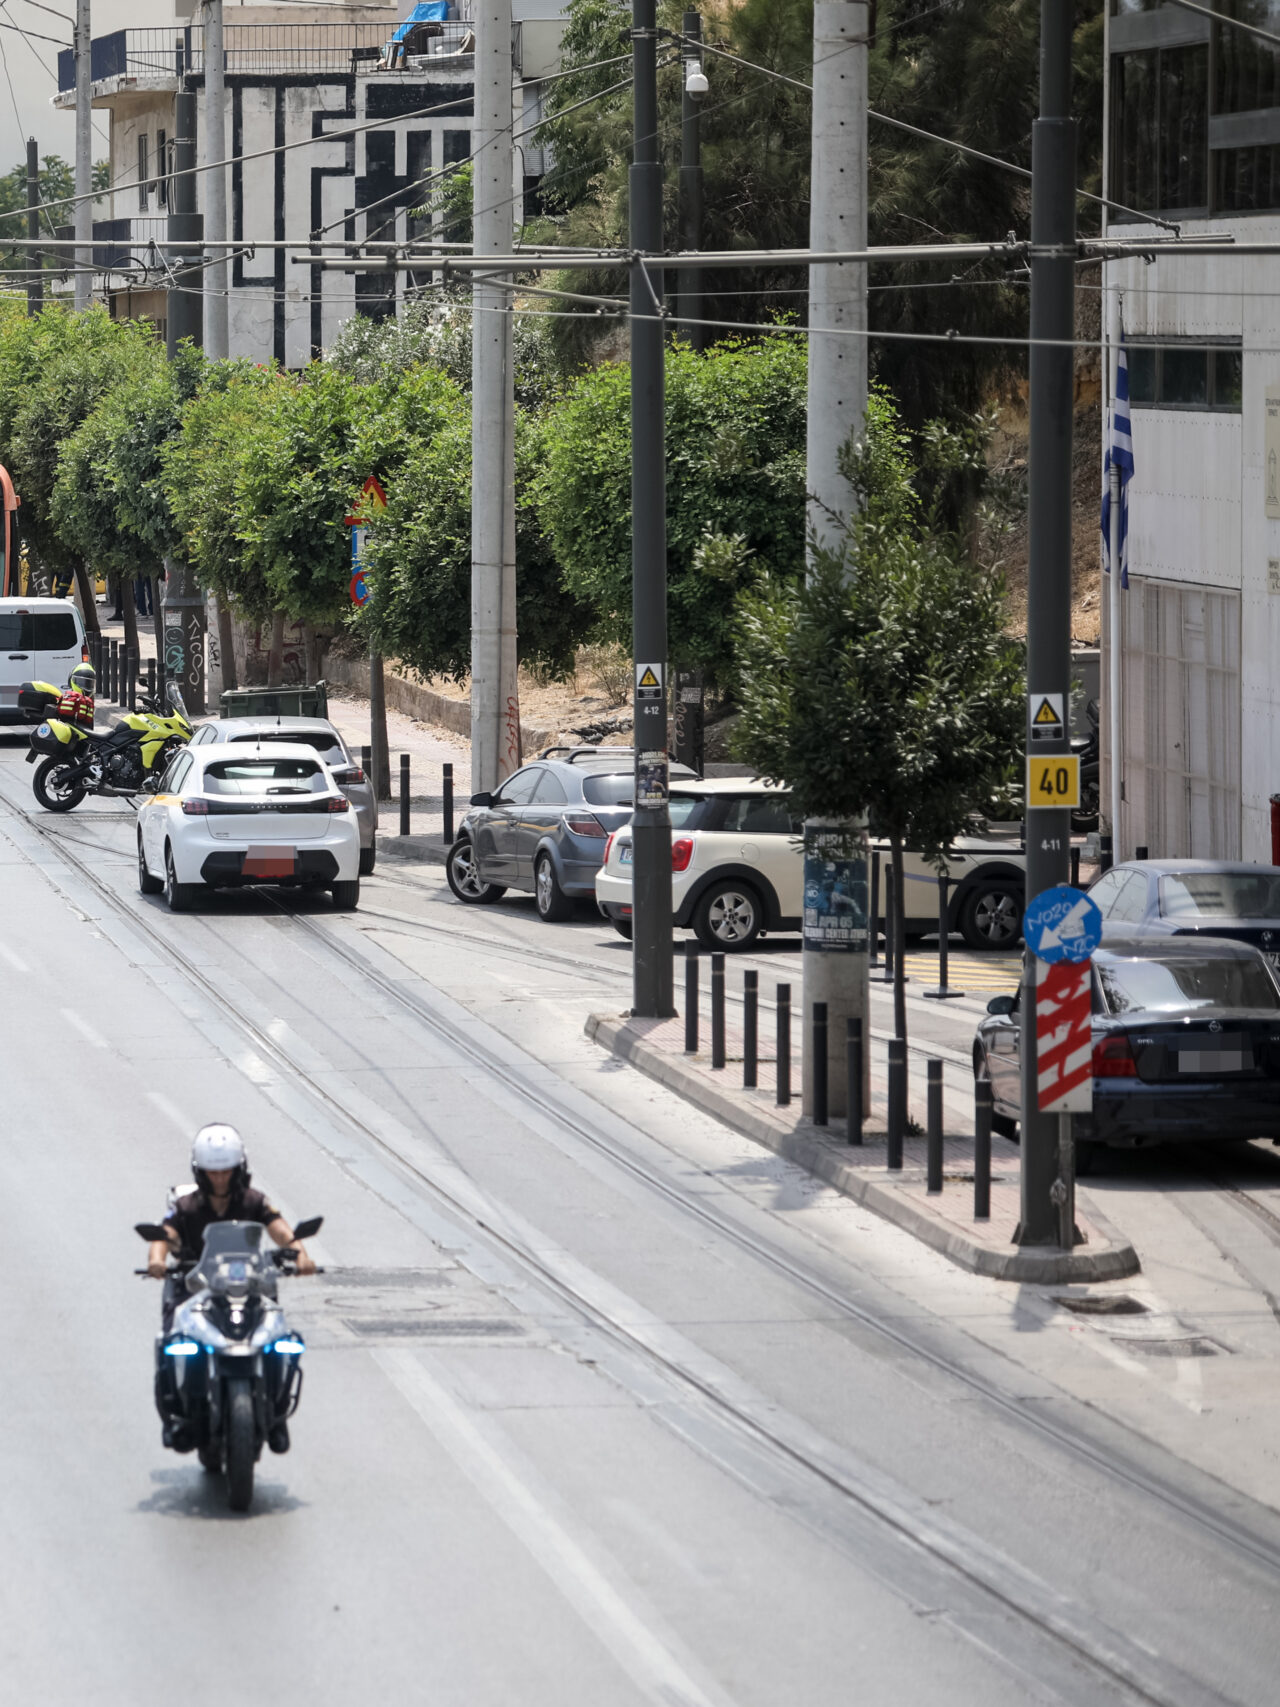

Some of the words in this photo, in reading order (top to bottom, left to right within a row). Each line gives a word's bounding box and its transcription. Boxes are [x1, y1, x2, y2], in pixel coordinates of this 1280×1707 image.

[643, 706, 660, 715] 4-12
[1039, 767, 1069, 795] 40
[1040, 839, 1061, 850] 4-11
